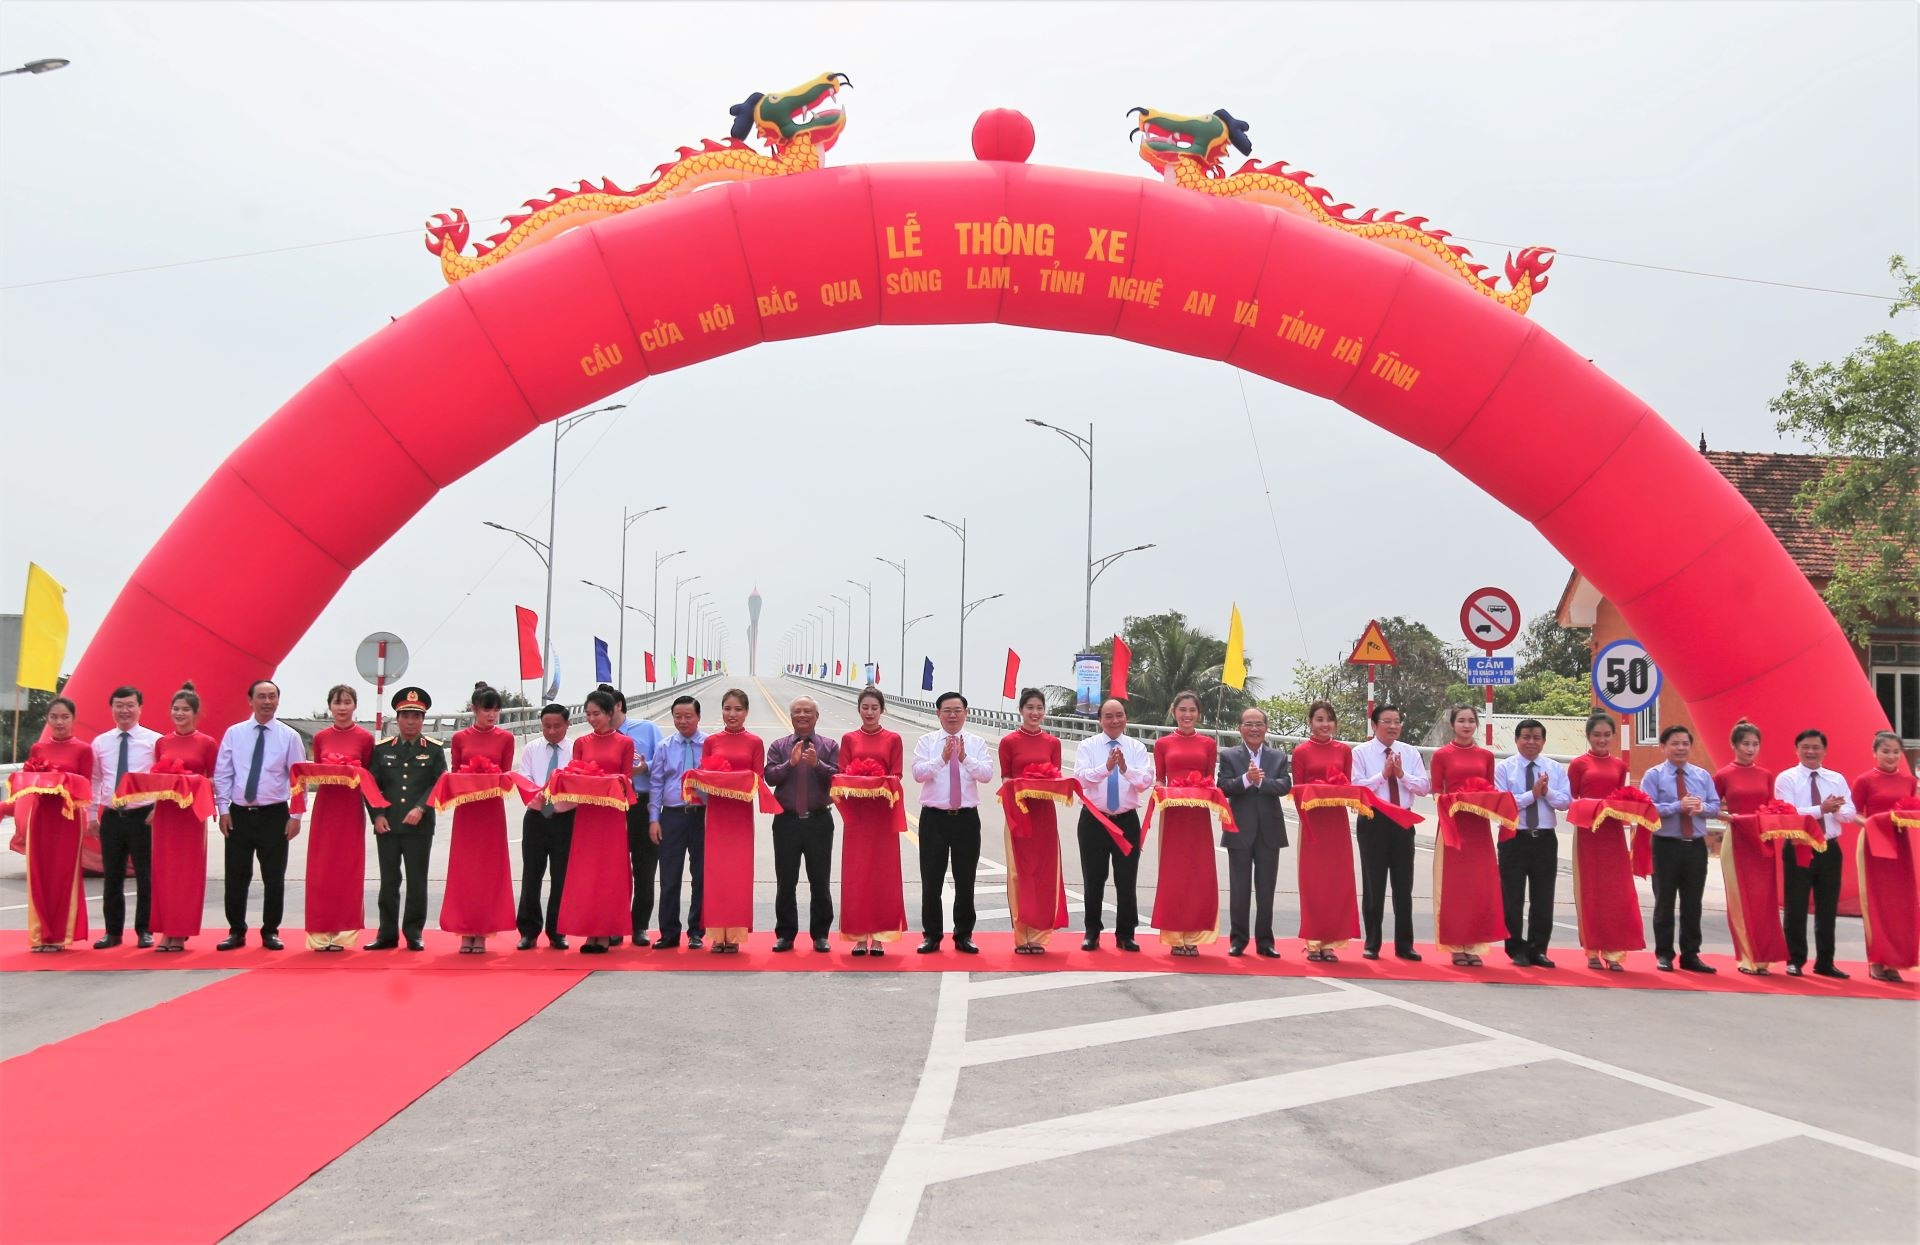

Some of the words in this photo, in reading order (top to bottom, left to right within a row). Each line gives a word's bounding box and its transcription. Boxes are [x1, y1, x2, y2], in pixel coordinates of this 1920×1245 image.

[886, 212, 923, 259] LỄ
[955, 216, 1055, 257] THÔNG
[1084, 227, 1128, 264] XE
[580, 344, 623, 377] CẦU
[640, 319, 684, 352] CỬA
[698, 303, 735, 333] HỘI
[758, 286, 798, 318] BẮC
[821, 279, 862, 306] QUA
[886, 267, 942, 295] SÔNG
[967, 266, 1019, 294] LAM,
[1039, 260, 1085, 295] TỈNH
[1108, 276, 1164, 308] NGHỆ
[1183, 290, 1217, 317] AN
[1233, 299, 1259, 328] VÀ
[1277, 310, 1326, 350] TỈNH
[1331, 336, 1363, 366] HÀ
[1370, 351, 1421, 392] TĨNH
[1476, 658, 1504, 668] CẤM
[1606, 657, 1649, 695] 50
